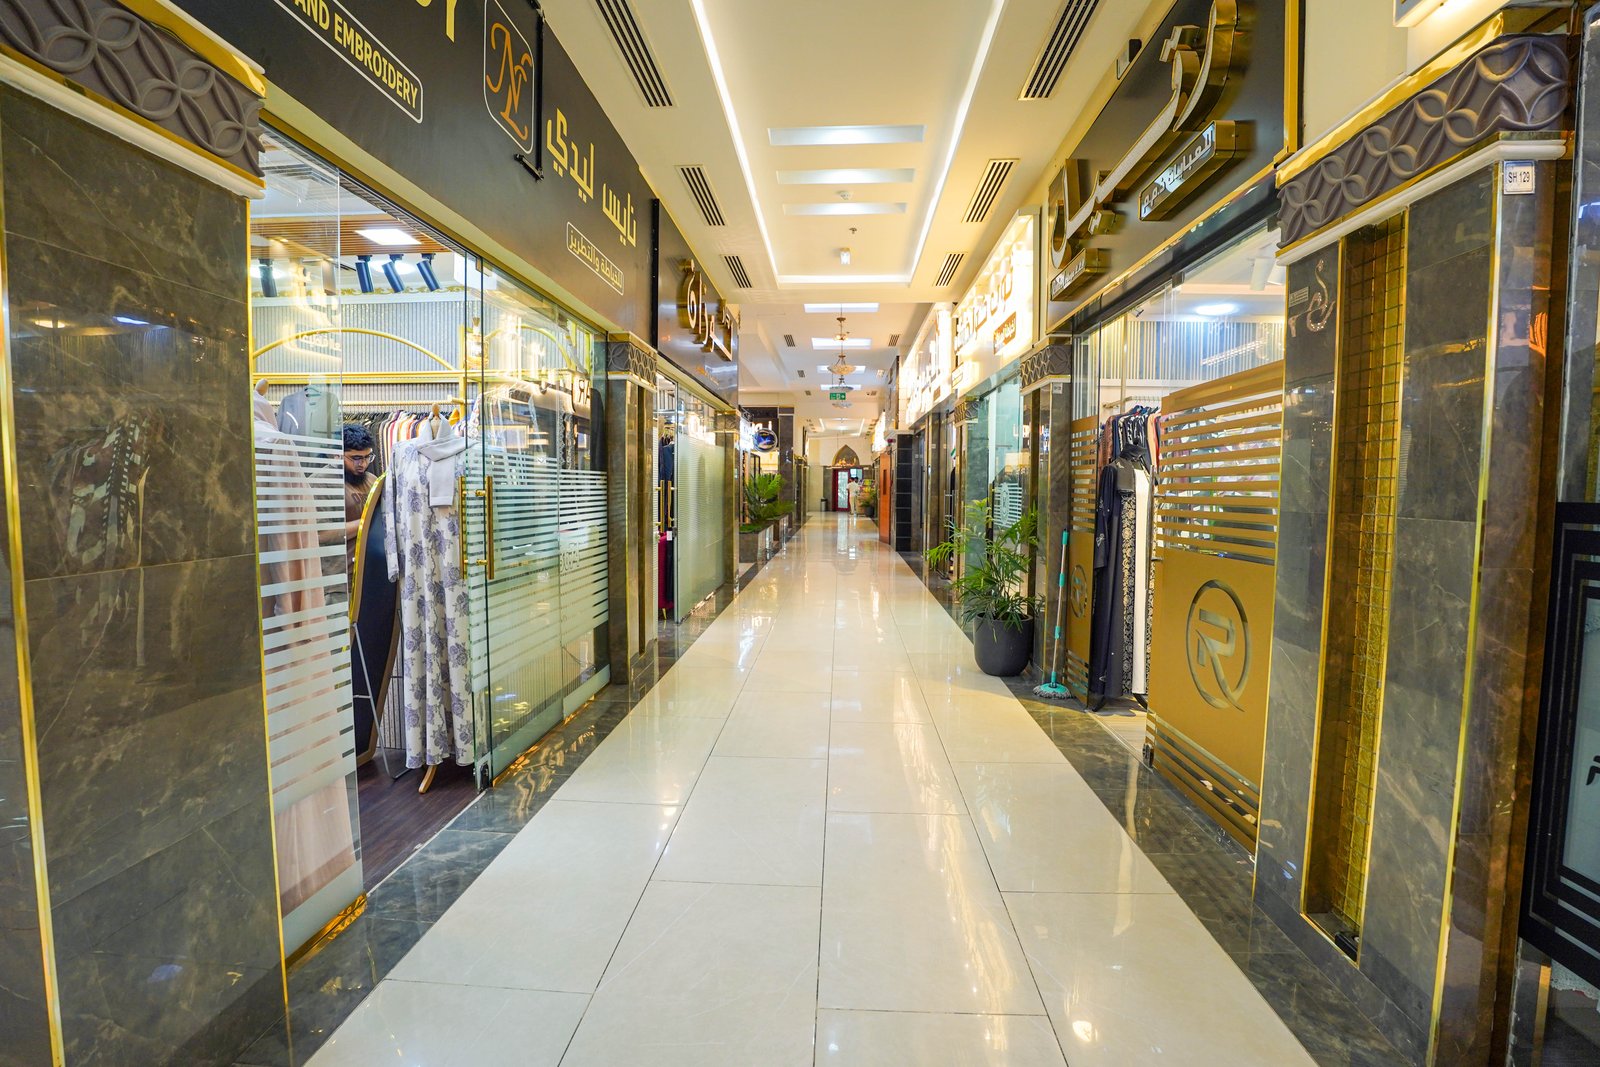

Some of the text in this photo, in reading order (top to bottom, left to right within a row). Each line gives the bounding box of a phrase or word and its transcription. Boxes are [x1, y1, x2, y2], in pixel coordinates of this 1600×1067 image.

[334, 12, 418, 109] EMBROIDERY
[546, 107, 637, 248] نايس ليدي
[1508, 171, 1518, 183] SH
